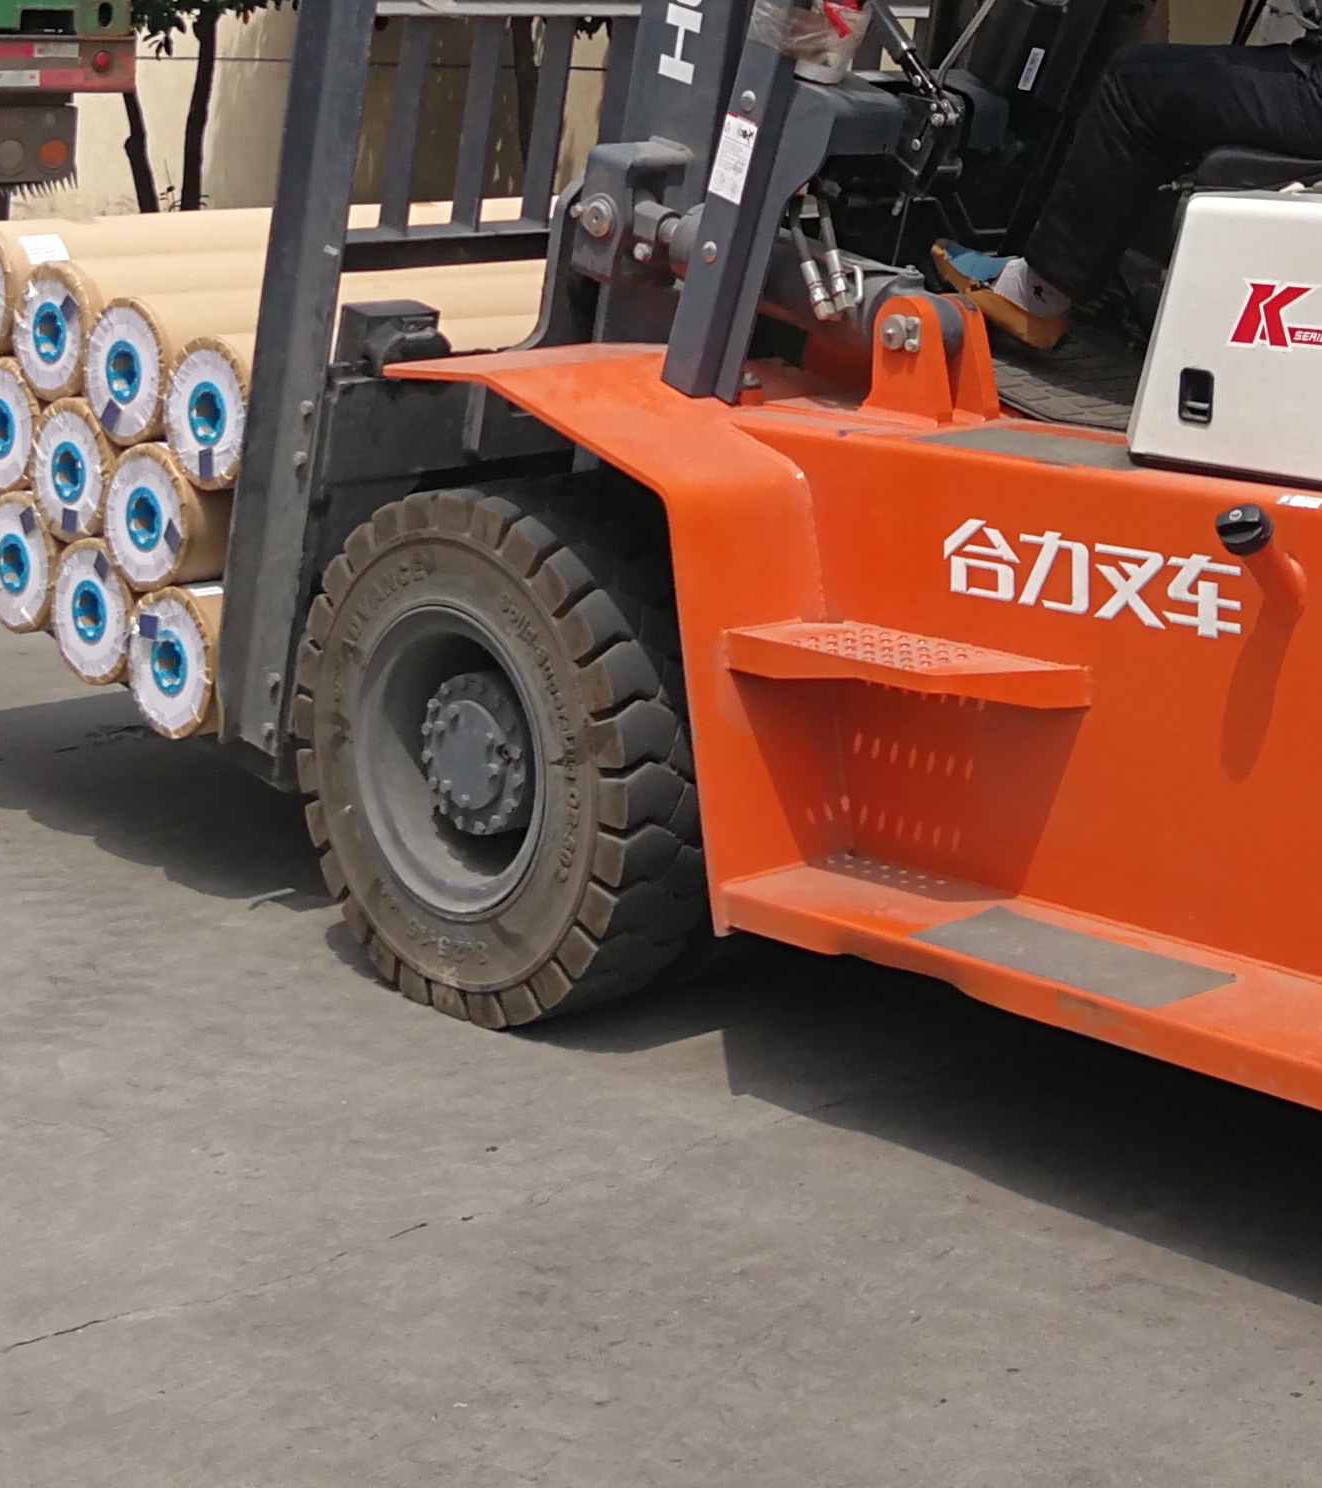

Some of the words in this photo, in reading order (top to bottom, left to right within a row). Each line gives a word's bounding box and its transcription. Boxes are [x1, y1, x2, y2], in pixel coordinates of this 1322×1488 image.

[1227, 279, 1320, 351] K
[943, 518, 1242, 639] 合力叉车
